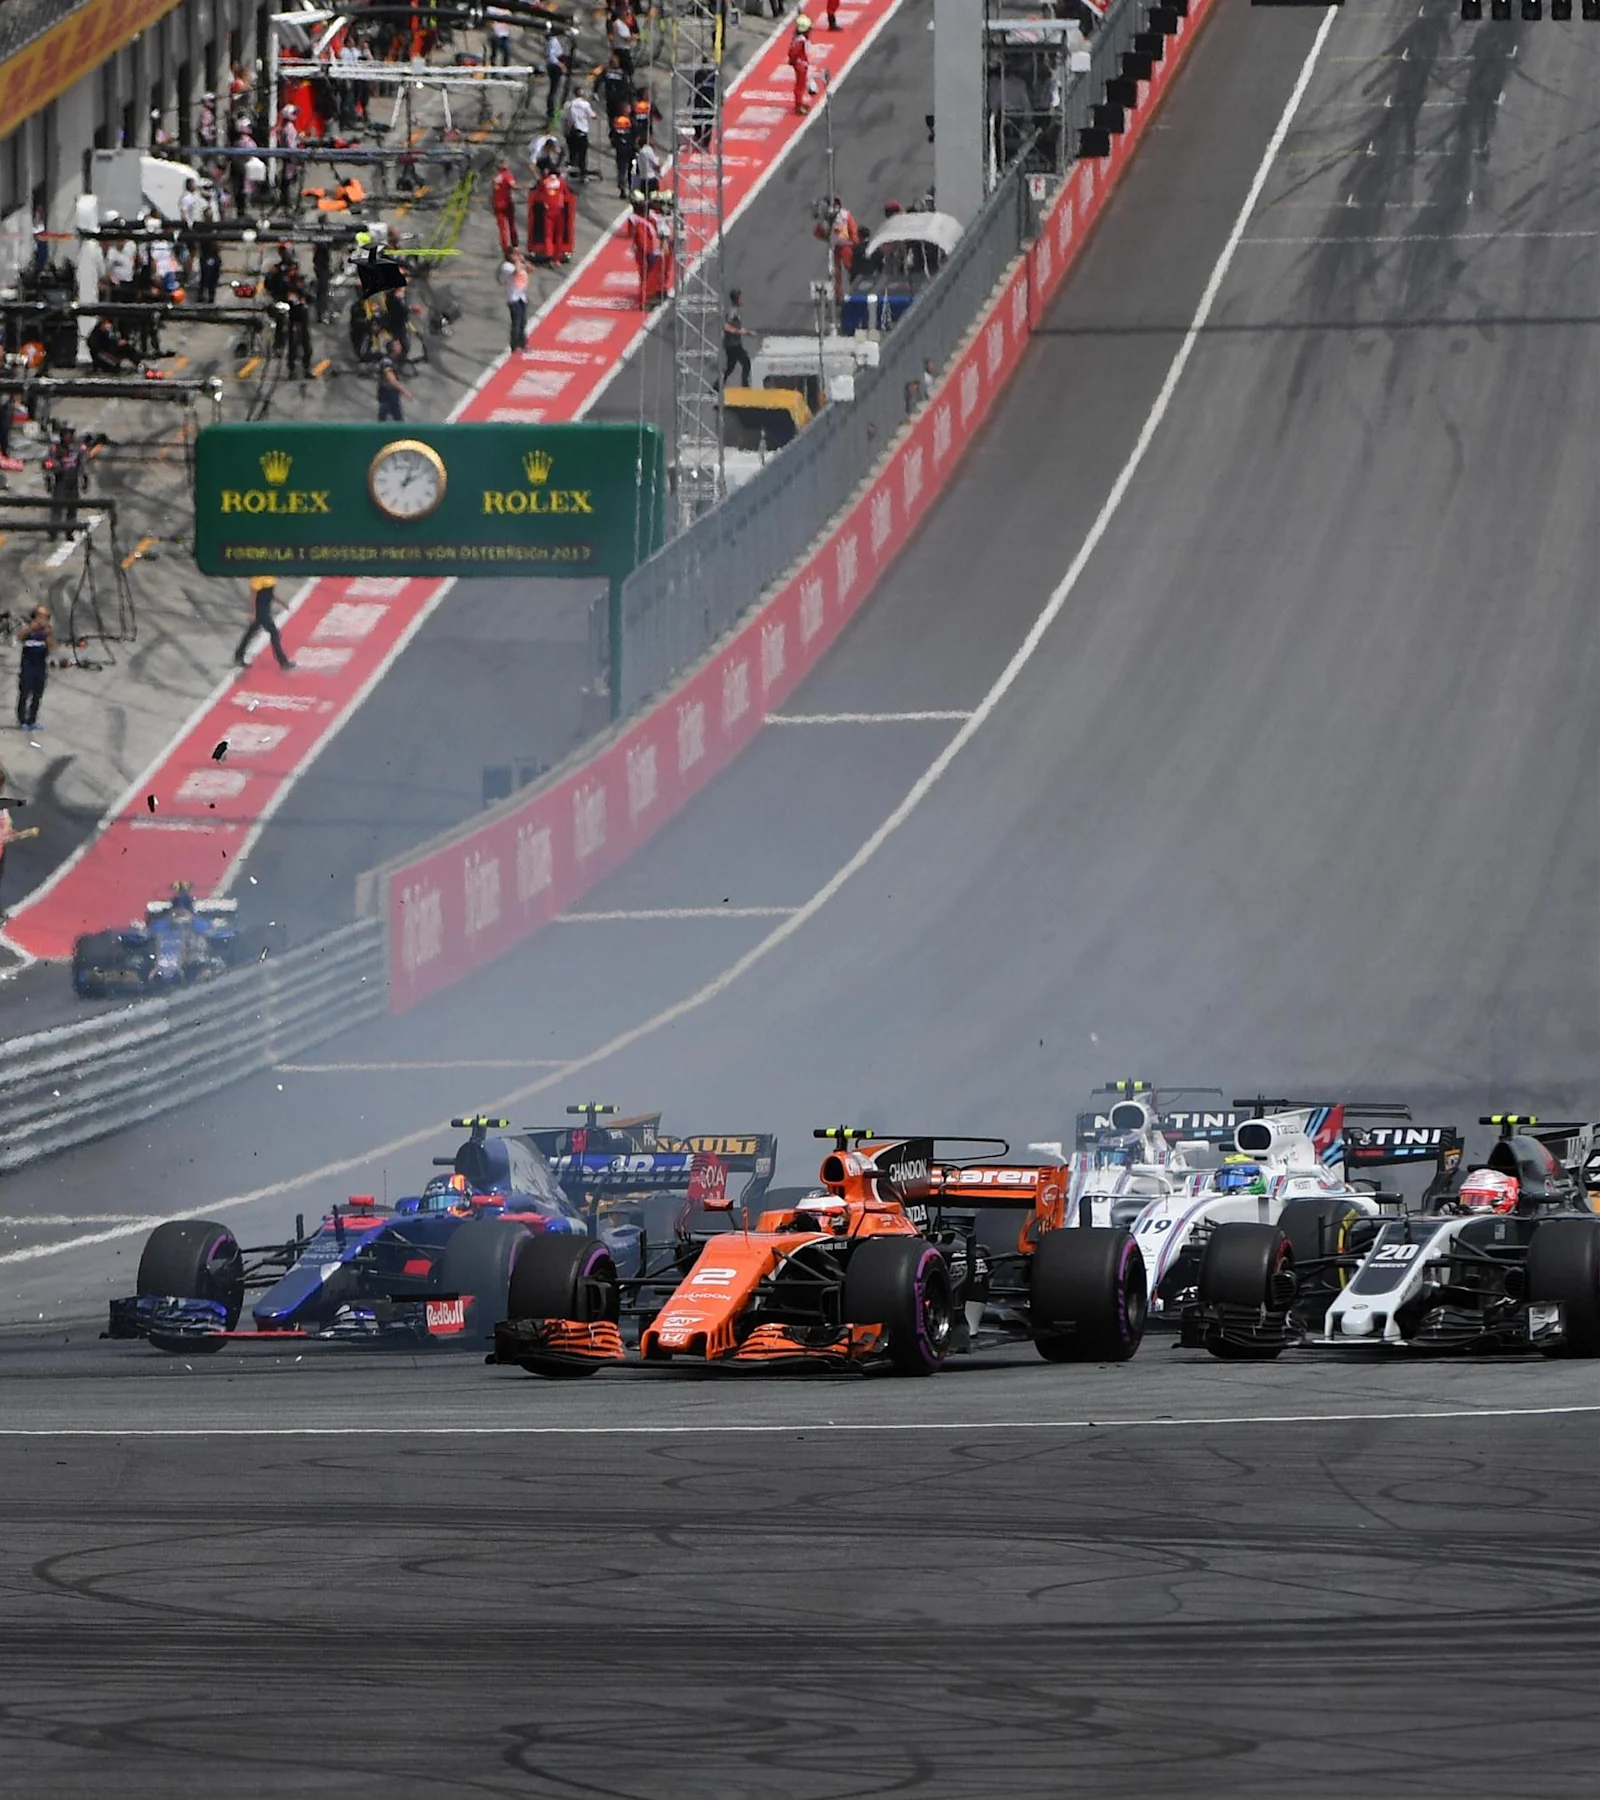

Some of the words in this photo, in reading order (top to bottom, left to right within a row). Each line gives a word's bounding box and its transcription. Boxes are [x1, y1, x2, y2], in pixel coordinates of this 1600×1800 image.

[221, 490, 331, 514] ROLEX
[482, 490, 594, 515] ROLEX
[1094, 1113, 1236, 1128] MTINI
[1140, 1219, 1173, 1234] 19
[1375, 1243, 1420, 1260] 20
[691, 1267, 738, 1286] 2
